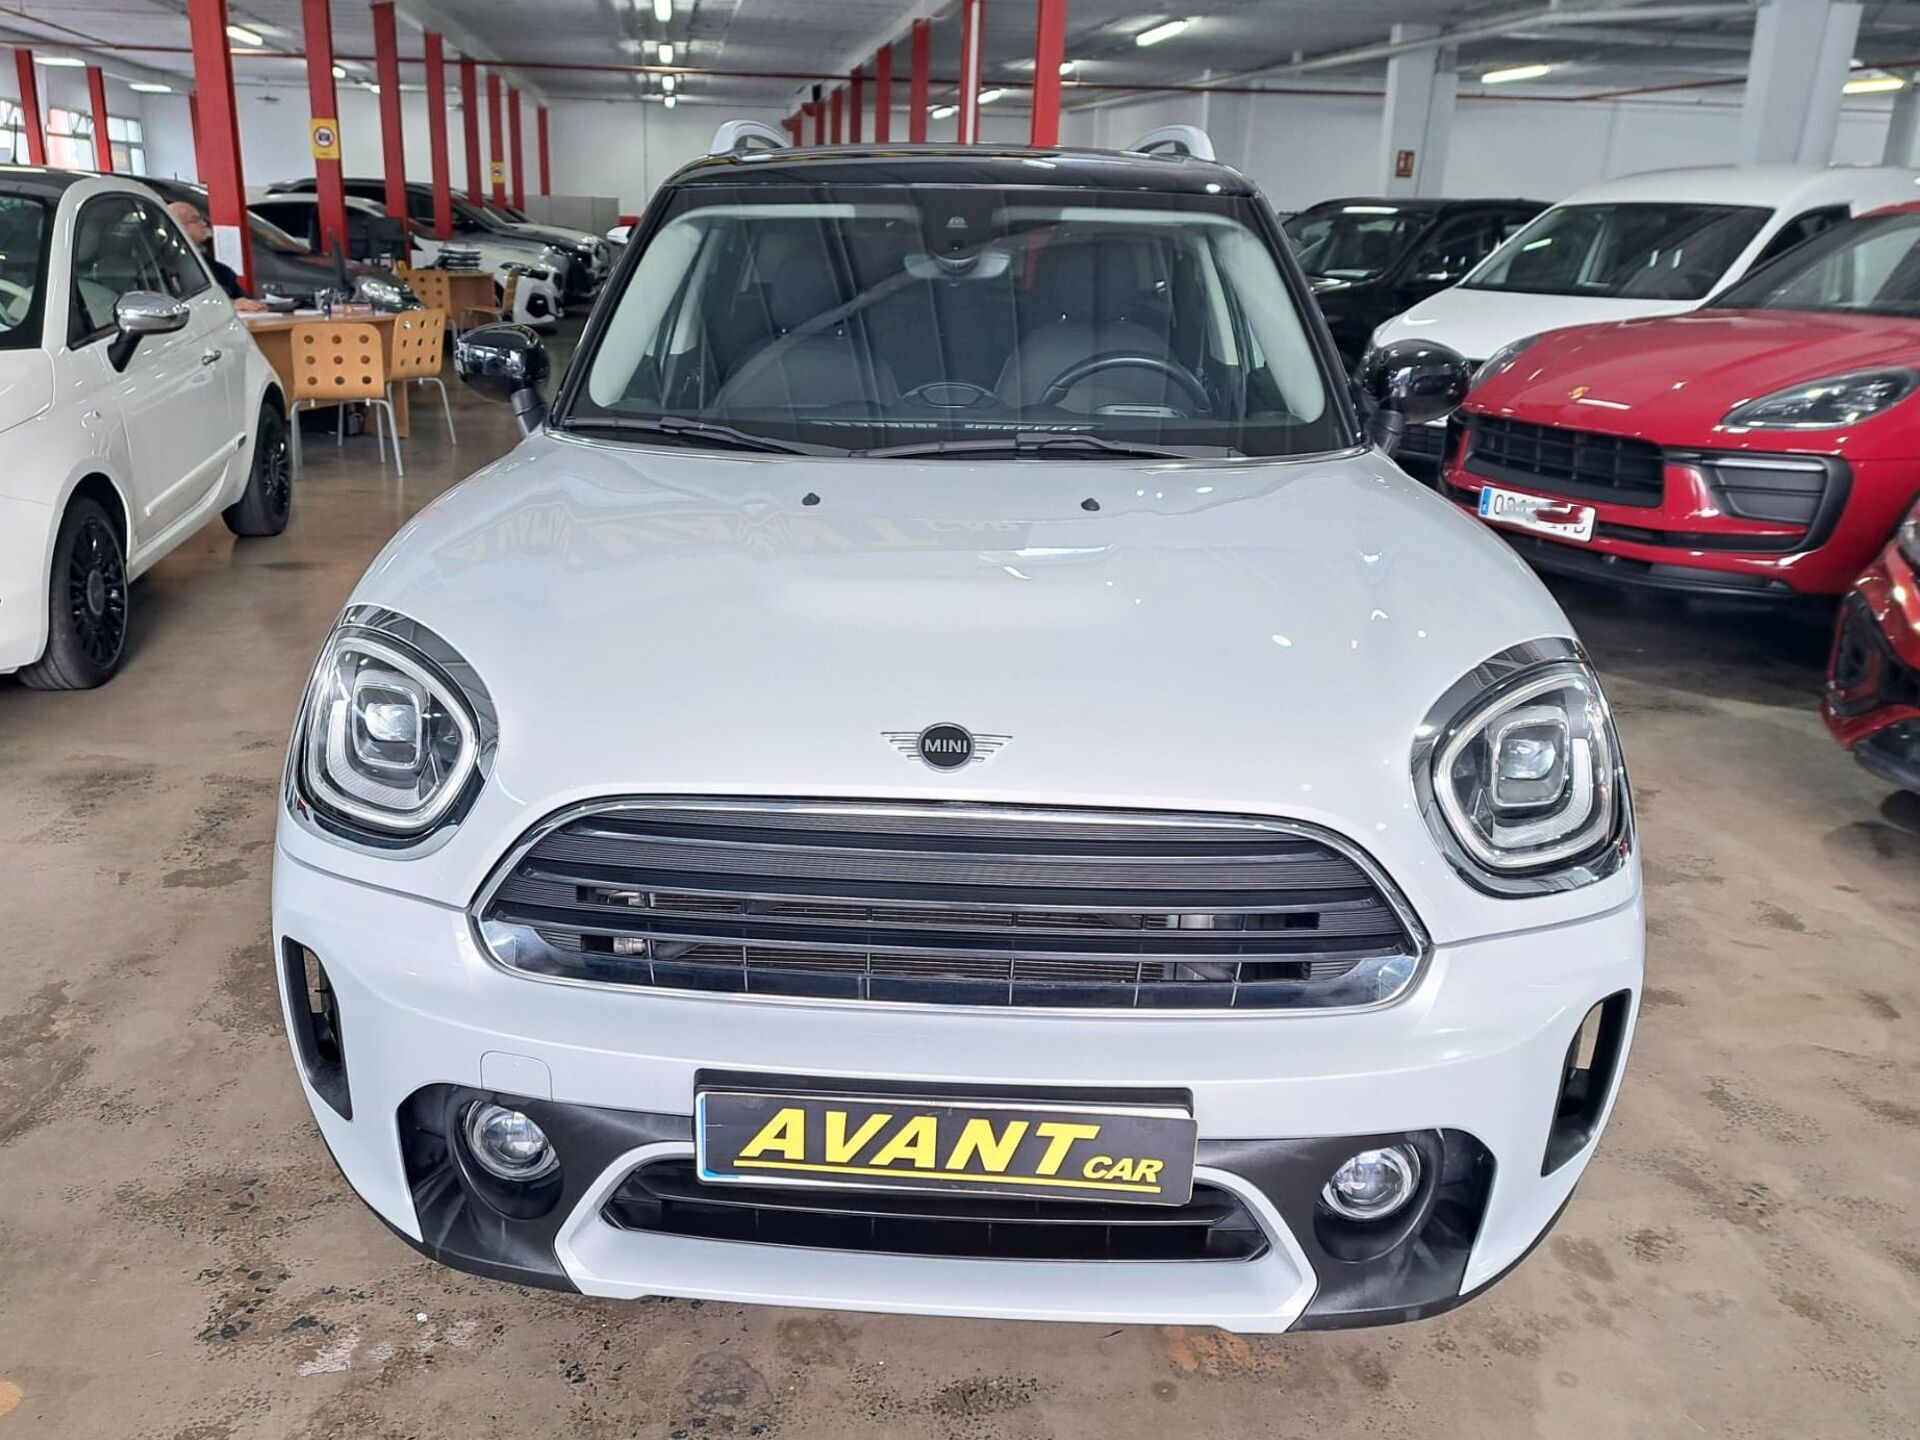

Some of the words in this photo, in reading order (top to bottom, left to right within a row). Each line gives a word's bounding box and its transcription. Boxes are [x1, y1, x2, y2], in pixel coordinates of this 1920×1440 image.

[924, 738, 968, 753] MINI
[738, 1108, 1101, 1175] AVANT
[1082, 1156, 1164, 1182] CAR
